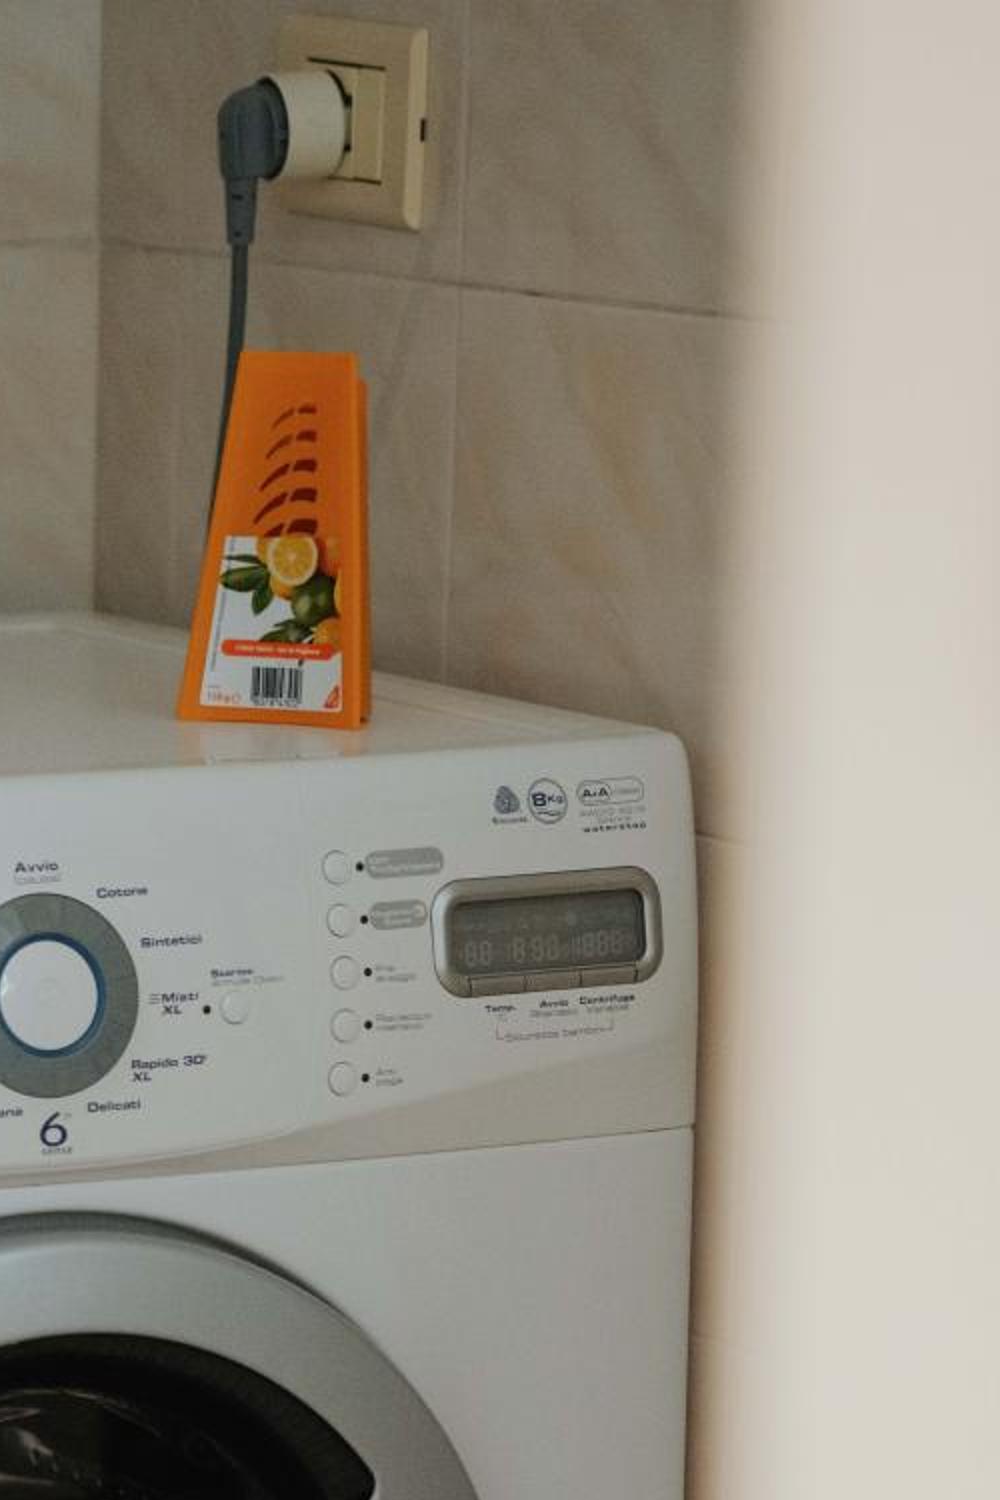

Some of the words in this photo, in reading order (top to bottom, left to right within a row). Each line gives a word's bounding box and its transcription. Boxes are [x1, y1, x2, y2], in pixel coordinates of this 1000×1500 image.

[15, 861, 59, 872] Avvio
[140, 935, 203, 948] Sintetici
[162, 1005, 182, 1015] XL
[131, 1058, 179, 1070] Rapido
[132, 1071, 152, 1082] XL
[87, 1099, 141, 1113] Delicati
[40, 1111, 67, 1147] 6
